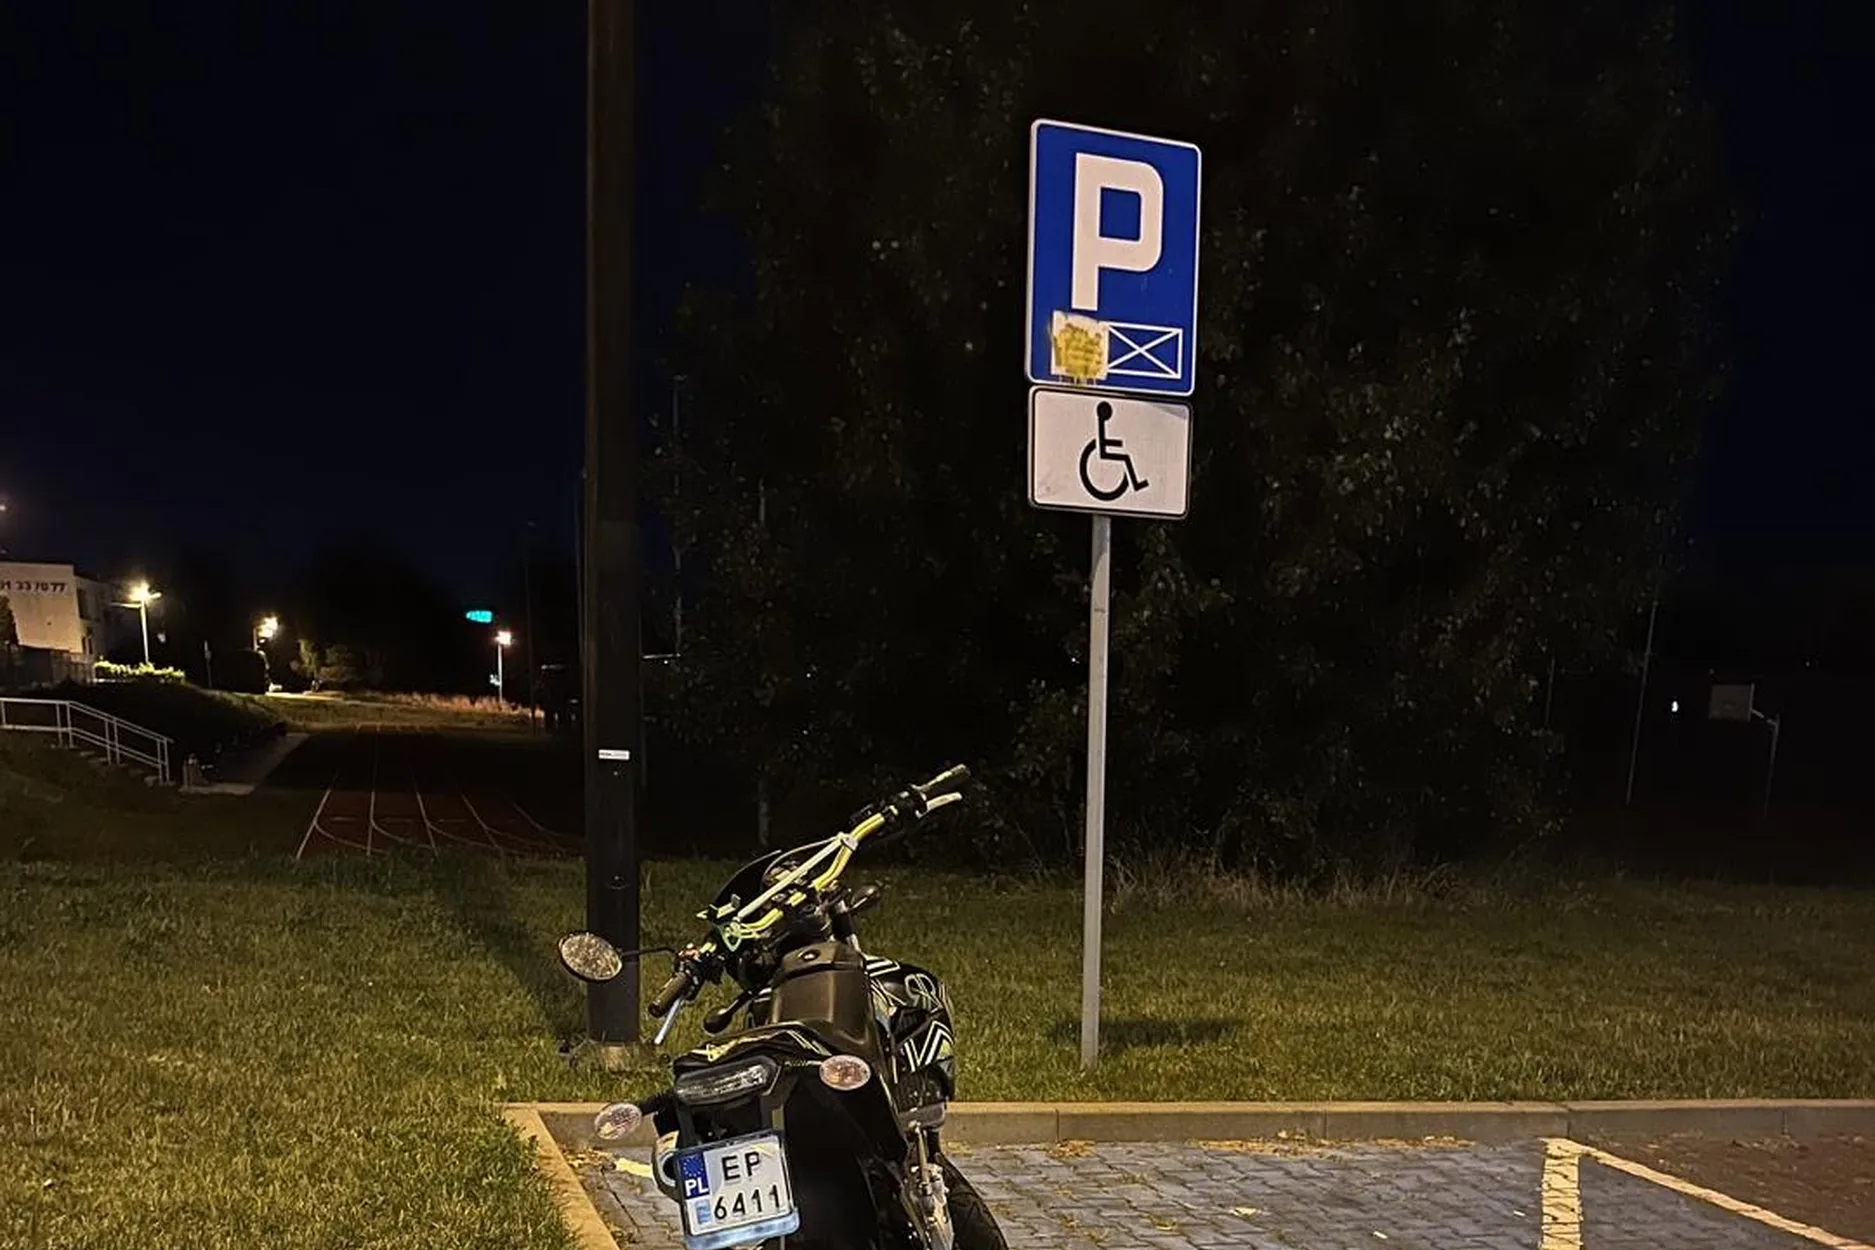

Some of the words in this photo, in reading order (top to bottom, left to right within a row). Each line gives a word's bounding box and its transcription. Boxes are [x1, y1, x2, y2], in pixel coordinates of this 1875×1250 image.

[1072, 153, 1163, 310] P
[721, 1151, 760, 1181] EP
[685, 1178, 708, 1197] PL
[714, 1184, 780, 1220] 6411
